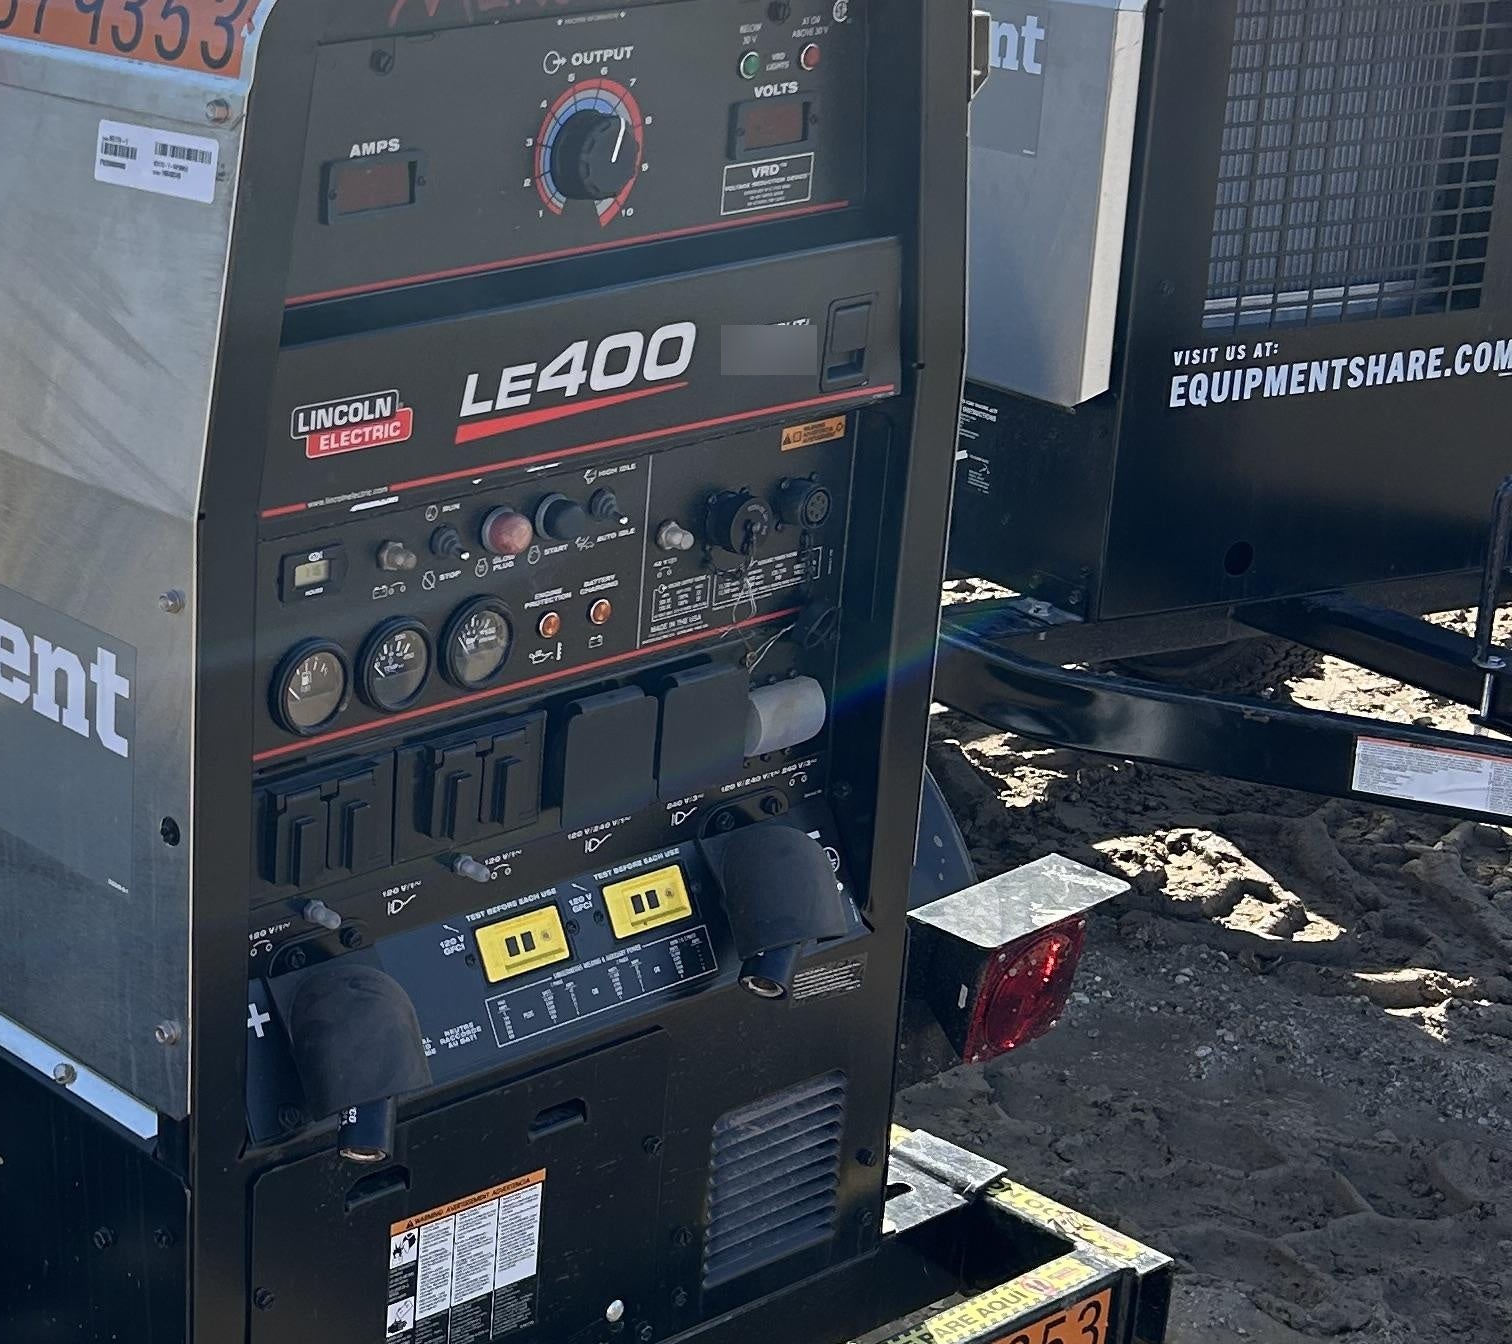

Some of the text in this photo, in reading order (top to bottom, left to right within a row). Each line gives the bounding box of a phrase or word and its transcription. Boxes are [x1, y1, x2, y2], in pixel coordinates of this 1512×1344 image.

[571, 46, 633, 66] OUTPUT
[567, 73, 576, 83] 5
[600, 66, 608, 76] 6
[629, 78, 637, 87] 7
[754, 81, 798, 97] VOLTS
[539, 99, 548, 109] 4
[349, 138, 400, 158] AMPS
[621, 207, 634, 217] 10
[1174, 342, 1279, 366] VISIT US AT:
[459, 321, 696, 417] LE400
[1170, 340, 1512, 407] EQUIPMENTSHARE.COM
[297, 396, 392, 433] LINCOLN
[319, 421, 401, 451] ELECTRIC
[439, 570, 462, 581] STOP
[593, 869, 612, 881] TEST
[466, 909, 485, 922] TEST
[518, 894, 539, 907] EACH
[540, 887, 557, 899] USE
